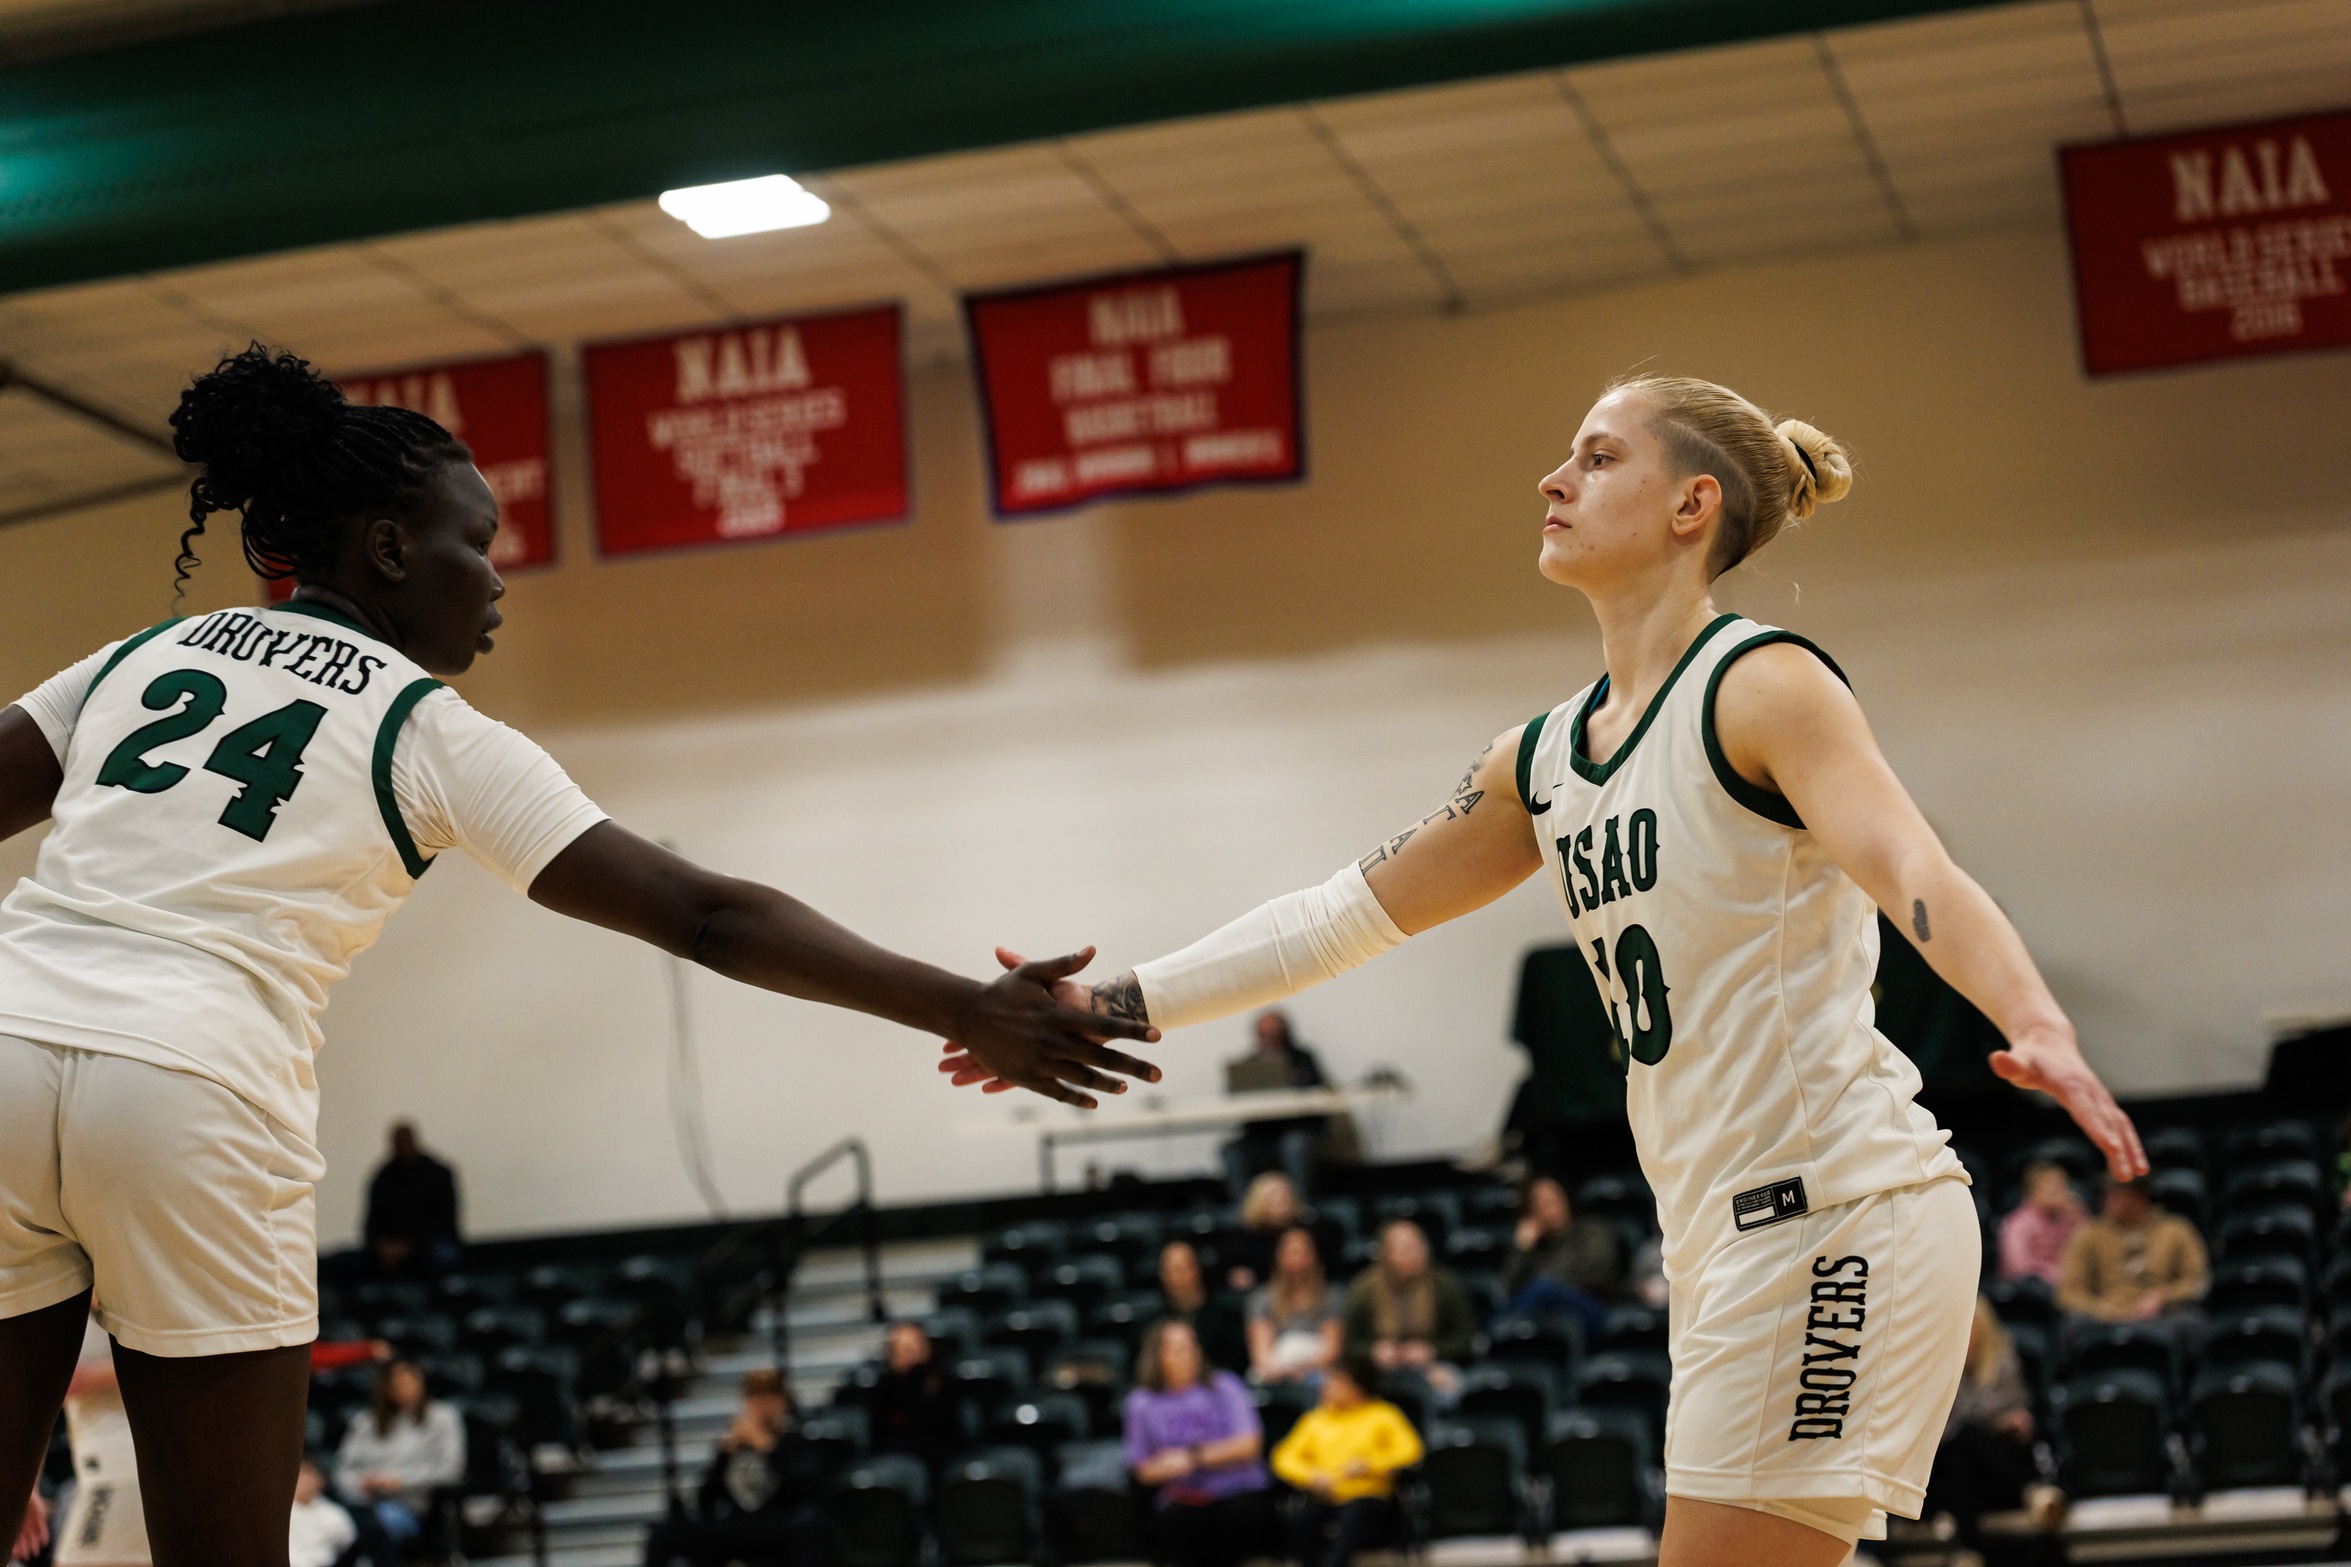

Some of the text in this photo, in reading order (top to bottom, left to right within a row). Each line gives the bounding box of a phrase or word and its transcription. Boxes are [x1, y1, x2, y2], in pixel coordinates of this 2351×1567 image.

[2168, 134, 2331, 222] NAIA
[2142, 214, 2351, 280] WORLD SERIE
[2175, 257, 2346, 312] BASEBALL
[1090, 286, 1185, 346] NAIA
[672, 324, 813, 403] NAIA
[1049, 333, 1233, 406] FINAL FOUR
[177, 611, 388, 695] DROVERS
[95, 668, 329, 843] 24
[1556, 807, 1661, 920] USAO
[1782, 1190, 1796, 1207] M
[1788, 1255, 1869, 1441] DROVERS
